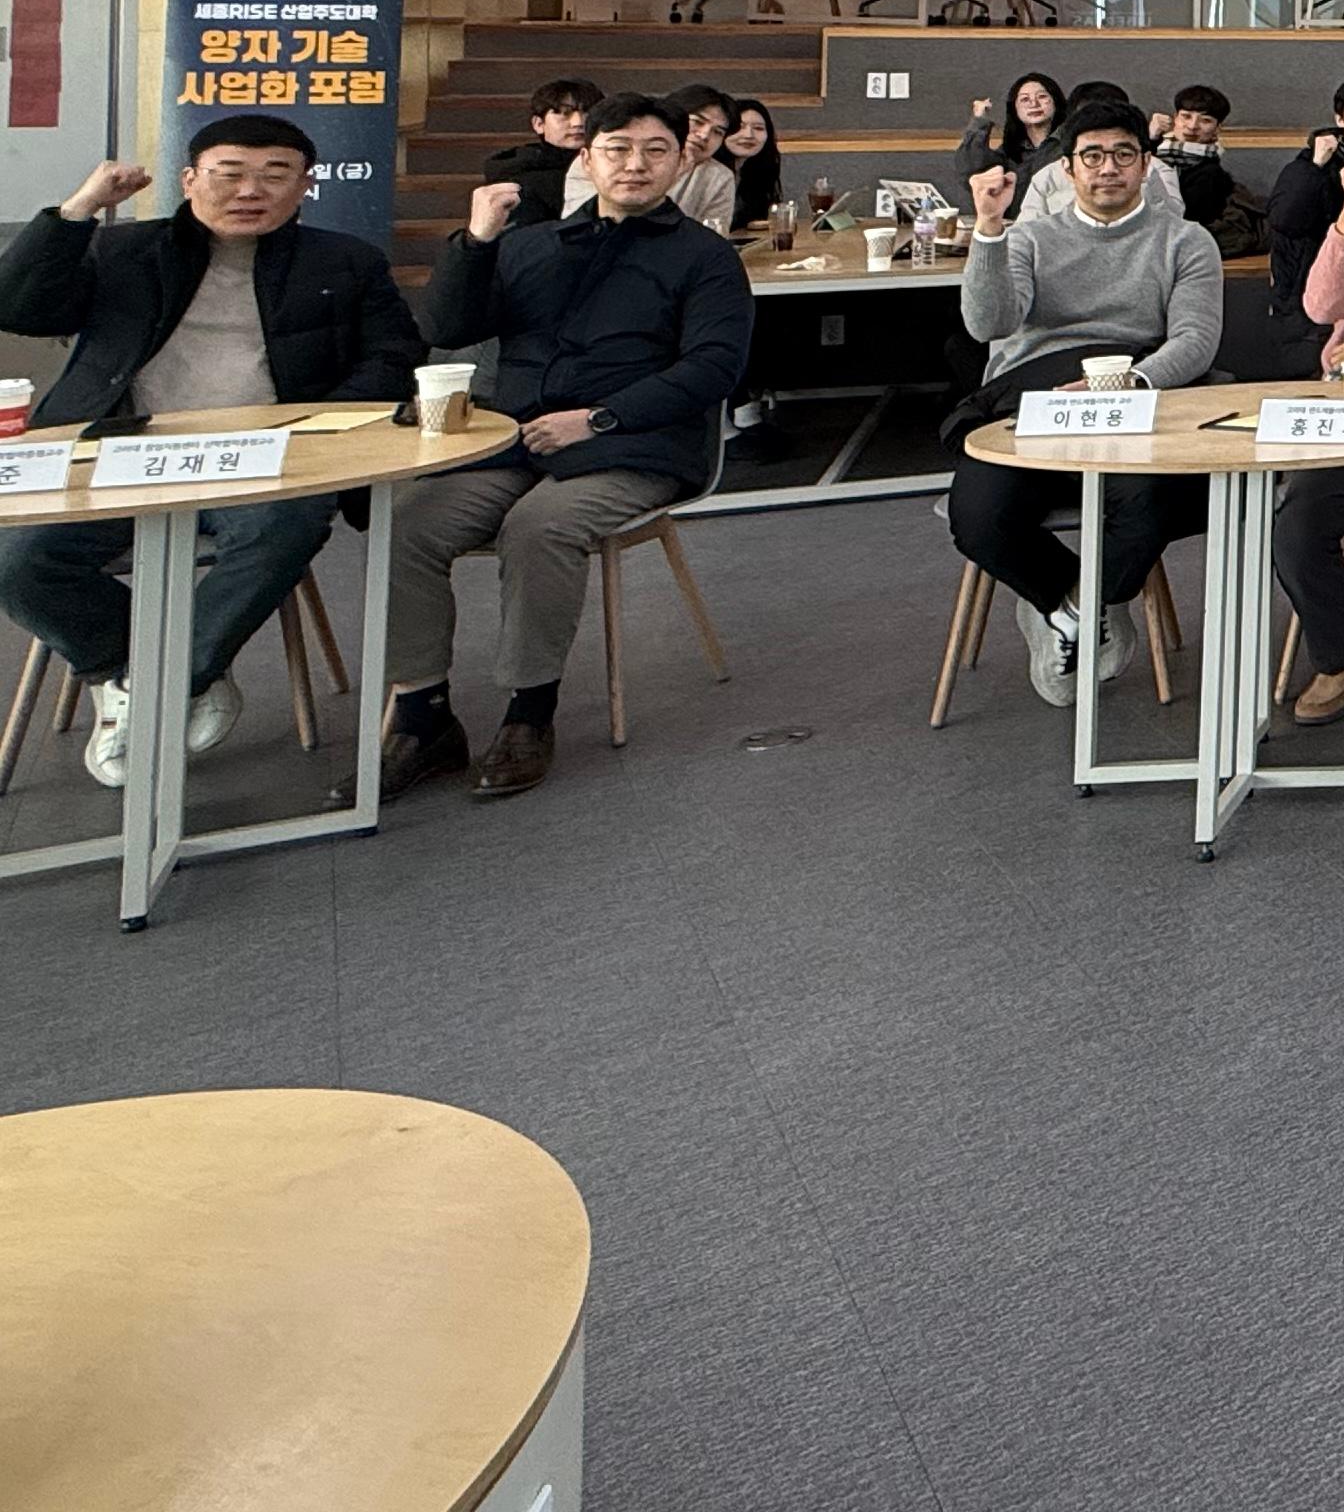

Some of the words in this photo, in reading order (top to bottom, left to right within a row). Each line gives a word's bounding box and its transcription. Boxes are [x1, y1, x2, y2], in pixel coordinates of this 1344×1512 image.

[194, 3, 277, 19] 세종RISE
[281, 4, 378, 20] 산업주도대학
[201, 30, 281, 63] 양자
[291, 30, 368, 63] 기술
[177, 71, 299, 105] 사업화
[309, 71, 386, 104] 포럼
[337, 162, 372, 180] (금)
